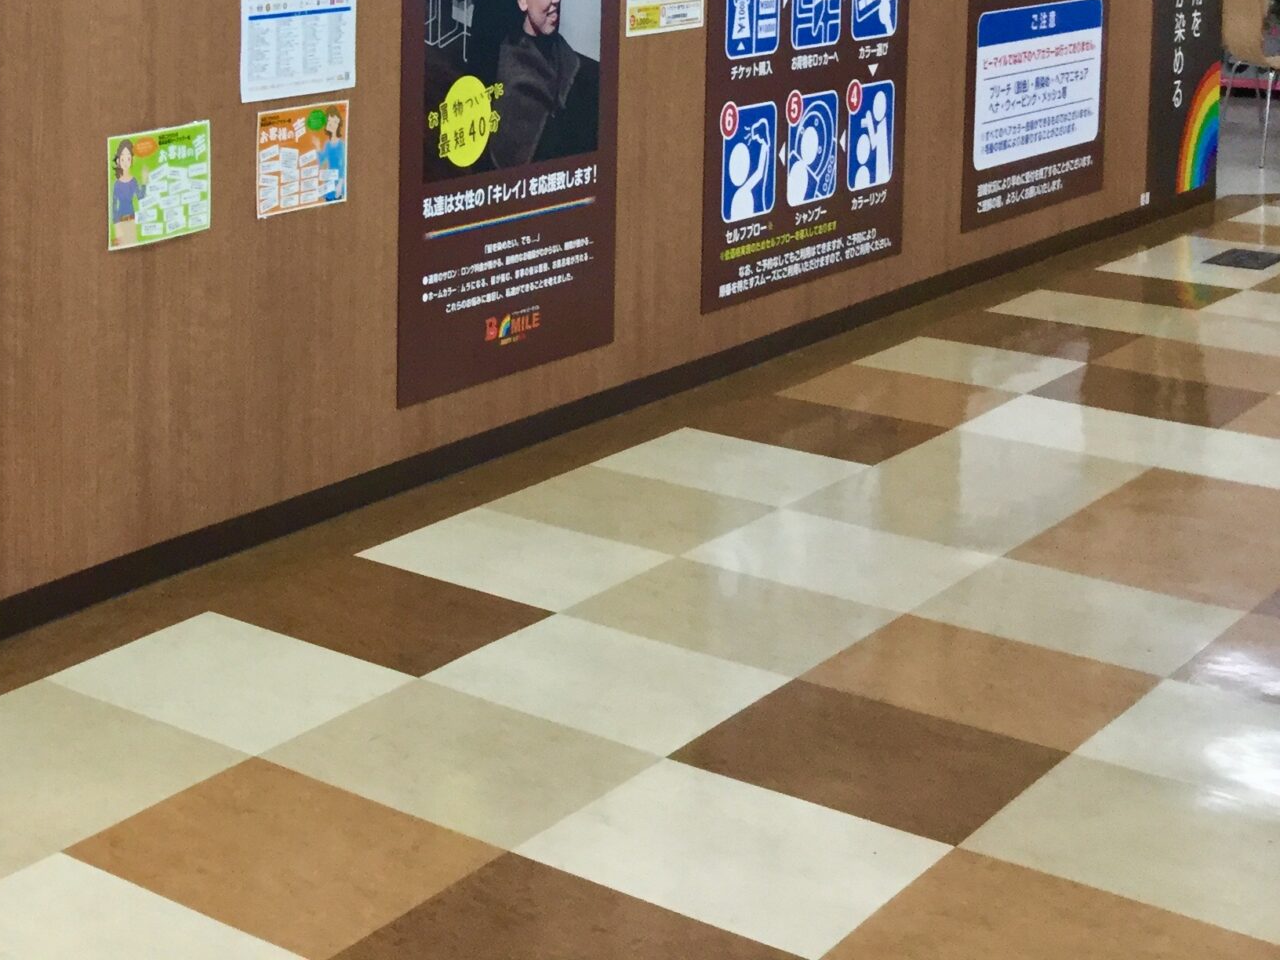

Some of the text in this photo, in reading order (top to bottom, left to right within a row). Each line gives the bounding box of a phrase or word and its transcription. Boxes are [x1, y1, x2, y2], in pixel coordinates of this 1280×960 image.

[1031, 11, 1056, 30] ご注意
[731, 61, 773, 80] チケット購入
[850, 86, 858, 107] 4
[790, 99, 798, 119] 5
[725, 110, 734, 131] 6
[439, 111, 501, 158] 最短40分
[851, 190, 887, 211] カラーリング
[795, 208, 827, 226] シャンプー
[511, 313, 540, 333] MILE
